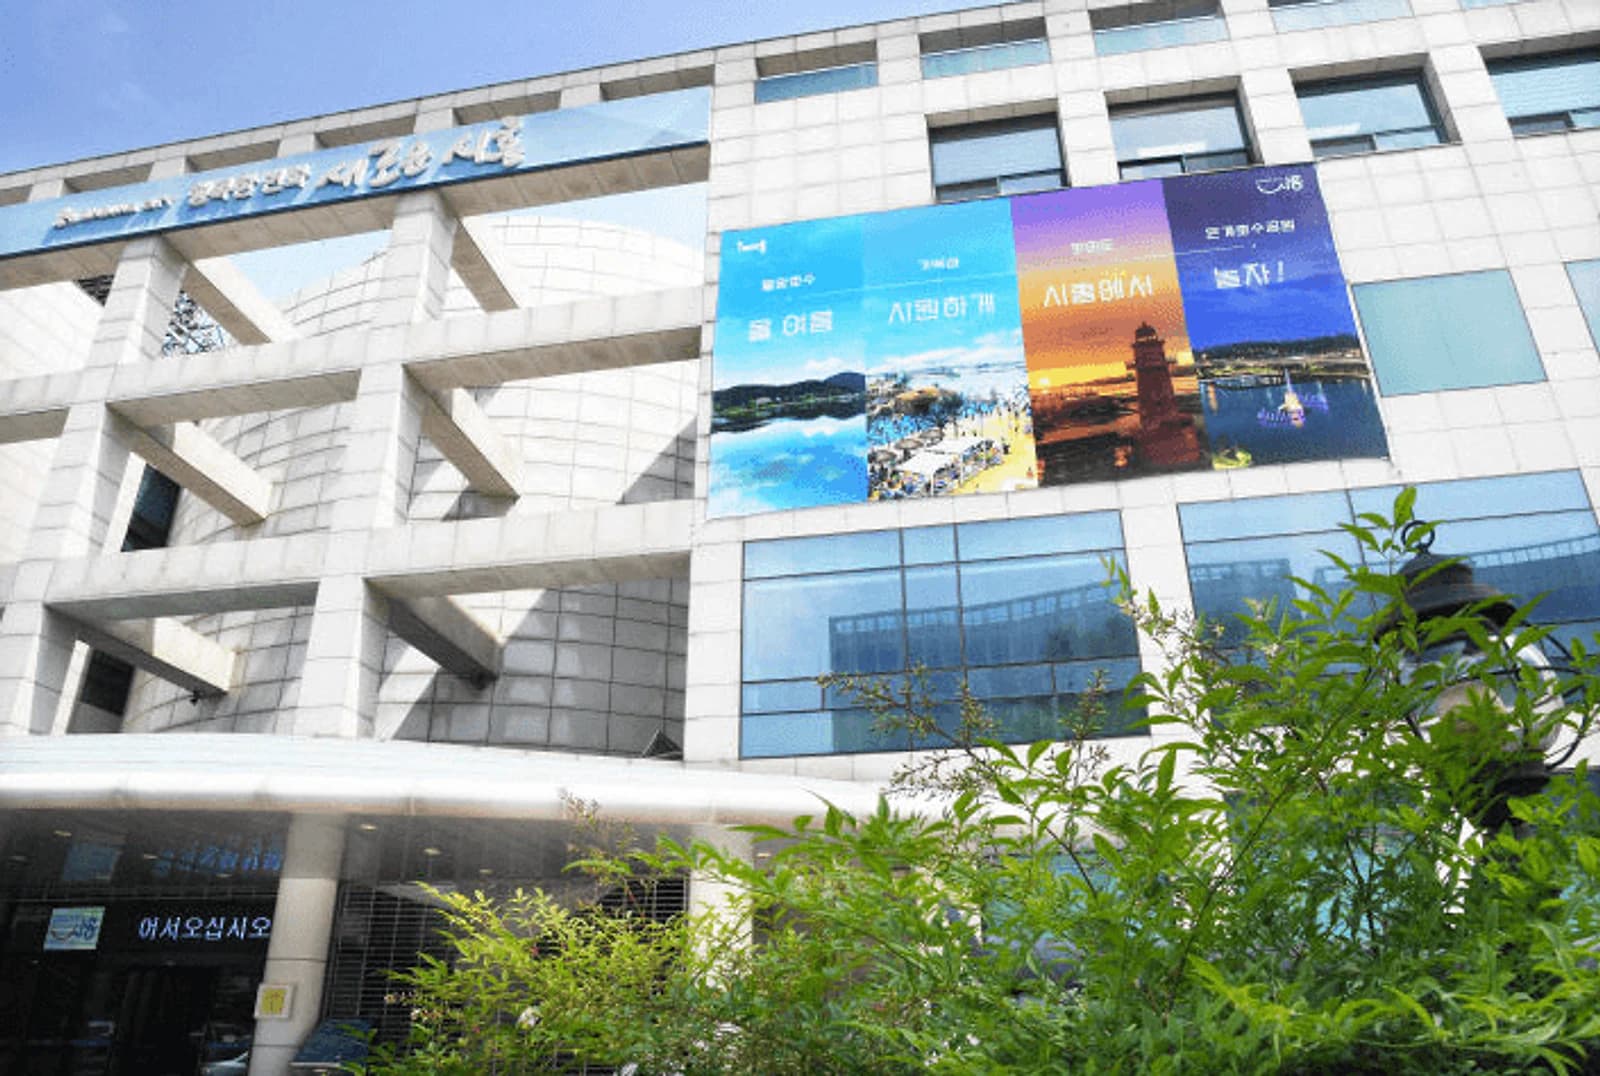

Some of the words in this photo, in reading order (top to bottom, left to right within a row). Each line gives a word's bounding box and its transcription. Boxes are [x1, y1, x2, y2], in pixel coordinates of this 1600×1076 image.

[315, 141, 431, 188] 새로운
[442, 116, 524, 168] 시흥
[1043, 274, 1153, 308] 시흥에서
[888, 293, 996, 325] 시원하게
[138, 916, 272, 941] 어서오십시오
